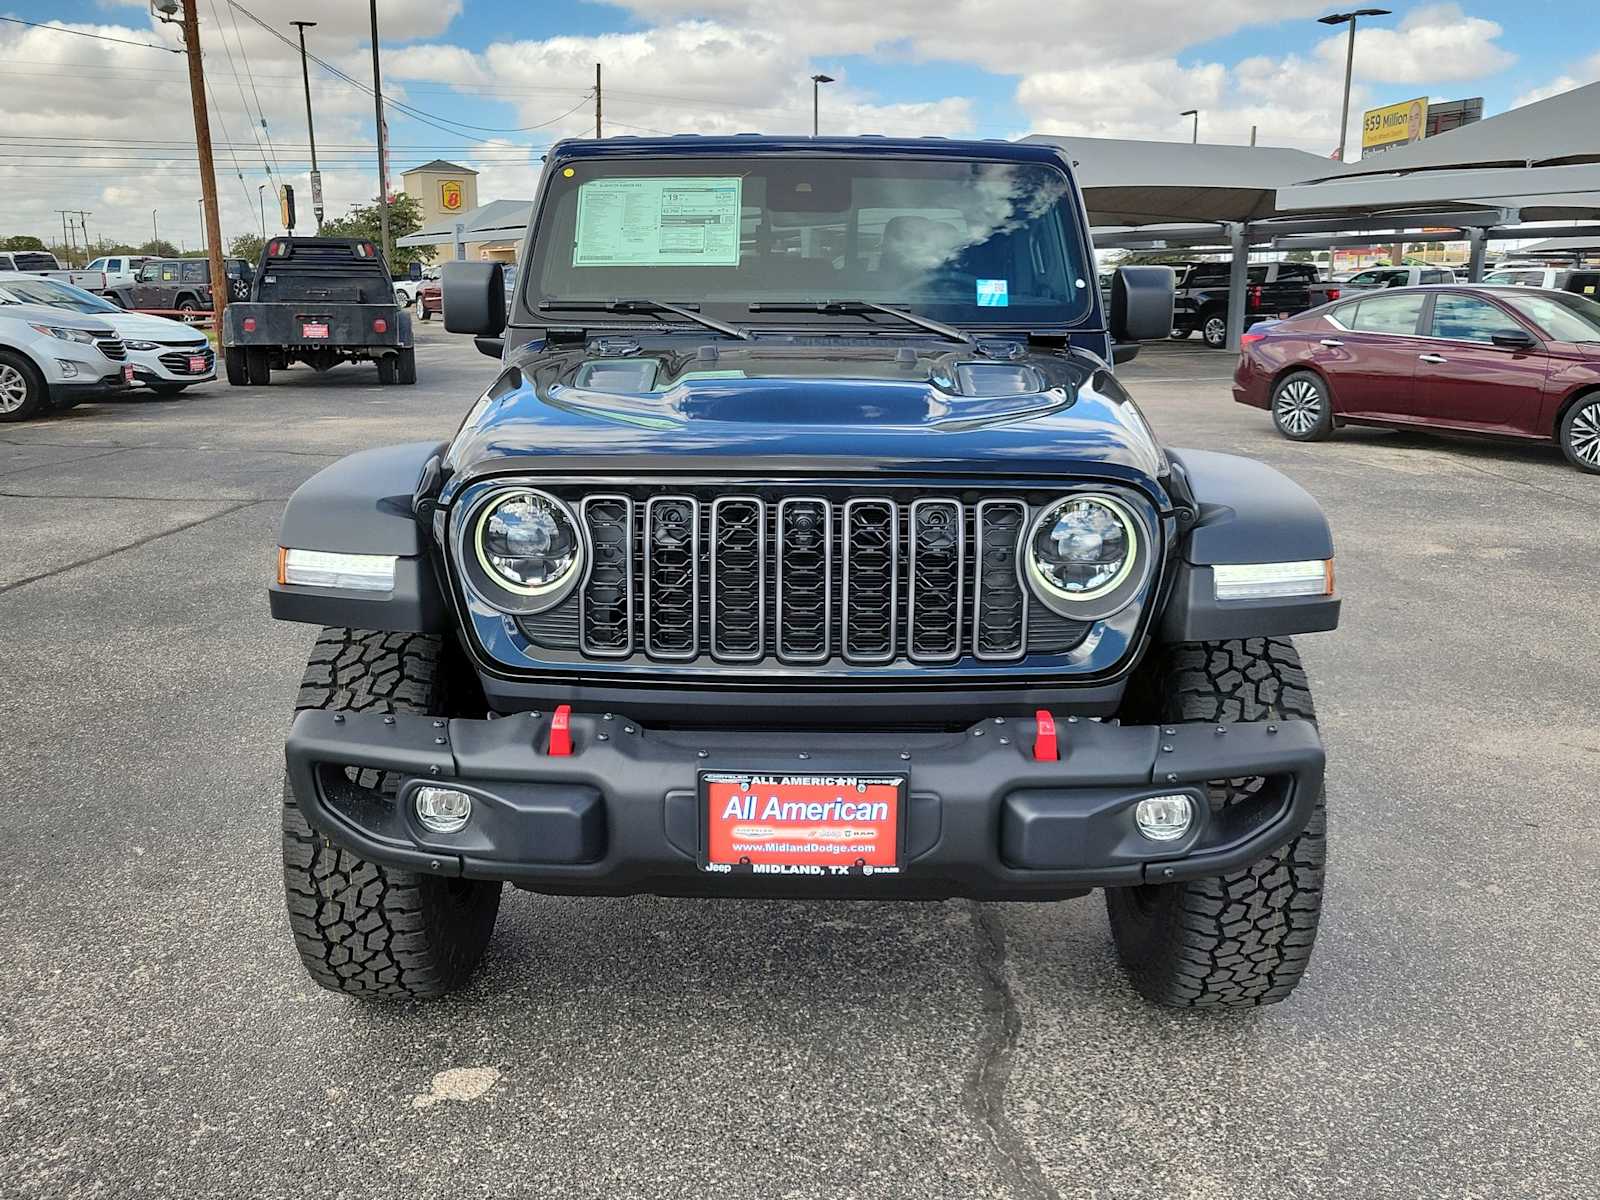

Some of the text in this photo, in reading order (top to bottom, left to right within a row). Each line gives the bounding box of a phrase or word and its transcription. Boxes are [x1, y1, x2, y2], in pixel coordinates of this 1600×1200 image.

[1365, 112, 1408, 131] $59 Million
[447, 192, 459, 207] 8
[751, 776, 778, 785] ALL
[722, 795, 888, 821] All American
[732, 842, 876, 854] www.MidlandDodge.com
[705, 862, 732, 874] Jeep
[753, 864, 849, 876] MIDLAND, TX
